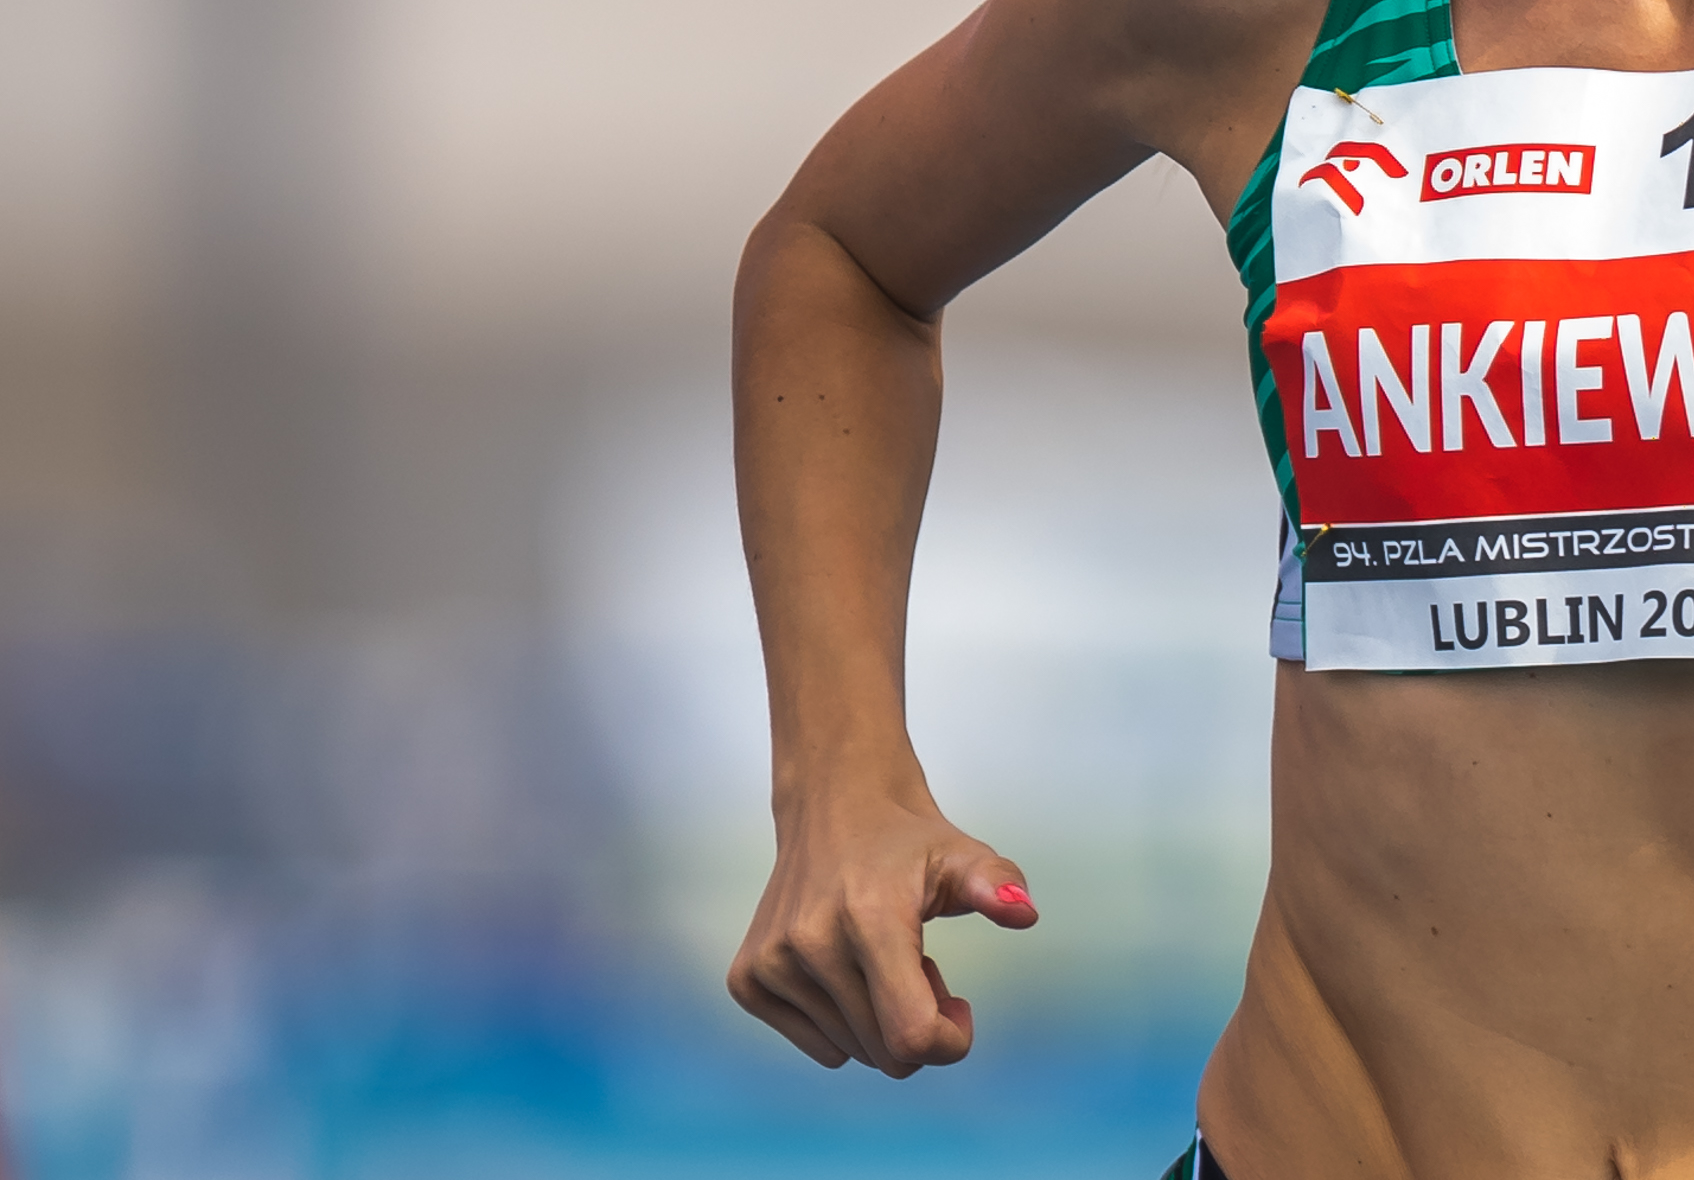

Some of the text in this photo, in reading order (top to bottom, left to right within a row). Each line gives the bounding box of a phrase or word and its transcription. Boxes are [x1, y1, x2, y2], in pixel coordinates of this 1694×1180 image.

[1430, 150, 1584, 193] ORLEN
[1333, 541, 1378, 567] 94.
[1383, 537, 1466, 566] PZLA
[1429, 593, 1624, 651] LUBLIN
